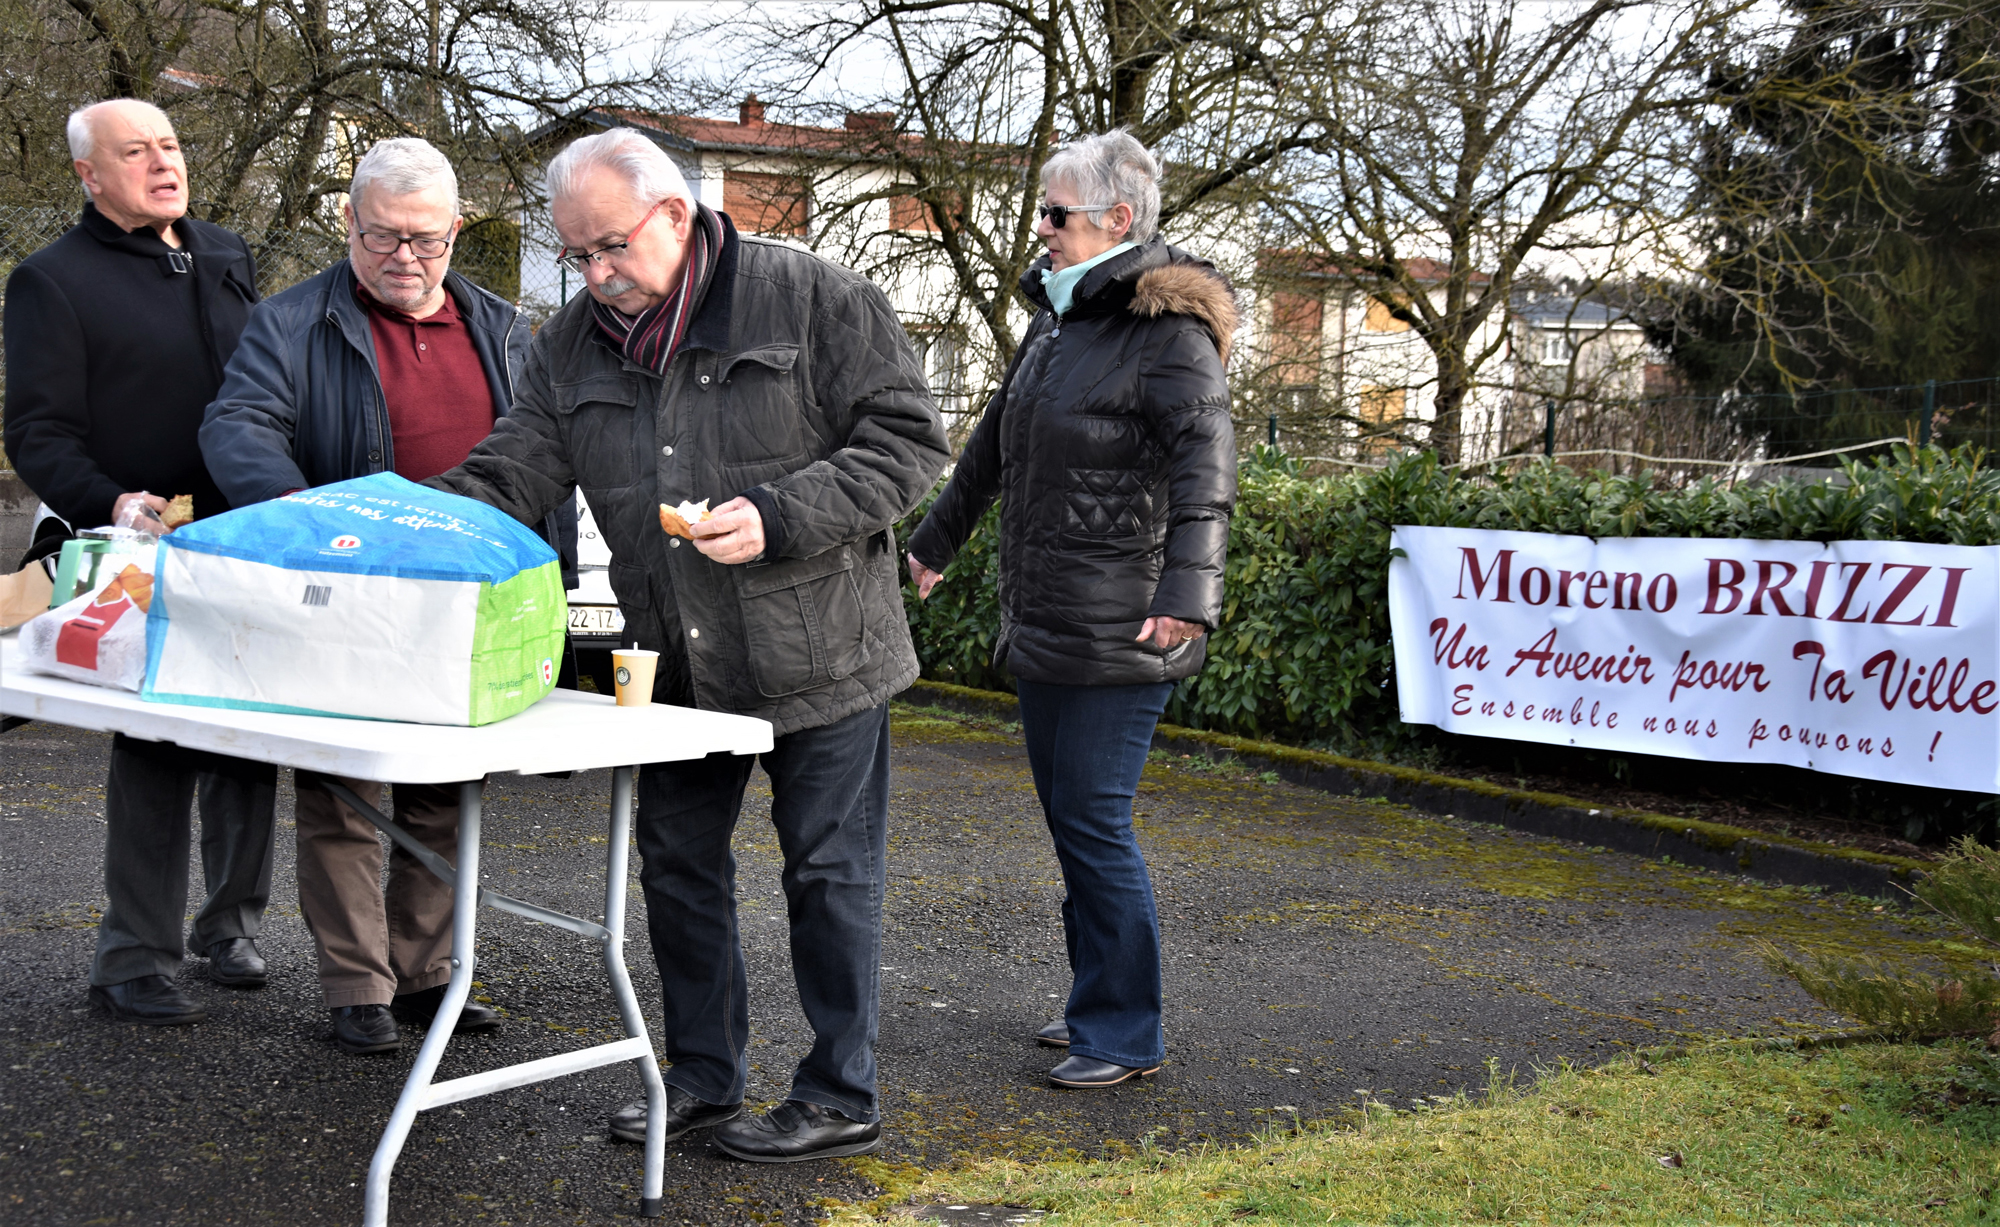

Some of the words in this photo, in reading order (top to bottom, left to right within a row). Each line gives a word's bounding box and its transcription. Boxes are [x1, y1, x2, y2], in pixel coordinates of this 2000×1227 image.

[568, 608, 614, 629] 22-TZ
[1453, 547, 1677, 614] Moreno
[1698, 557, 1971, 628] BRIZZI
[1429, 616, 1490, 671] Un
[1506, 627, 1655, 686] Avenir
[1669, 650, 1770, 703] pour
[1792, 640, 1855, 703] Ta
[1862, 649, 1999, 715] Ville
[1451, 684, 1619, 729] Ensemble
[1643, 716, 1719, 738] nous
[1748, 718, 1895, 758] pouvons
[1928, 730, 1943, 762] !
